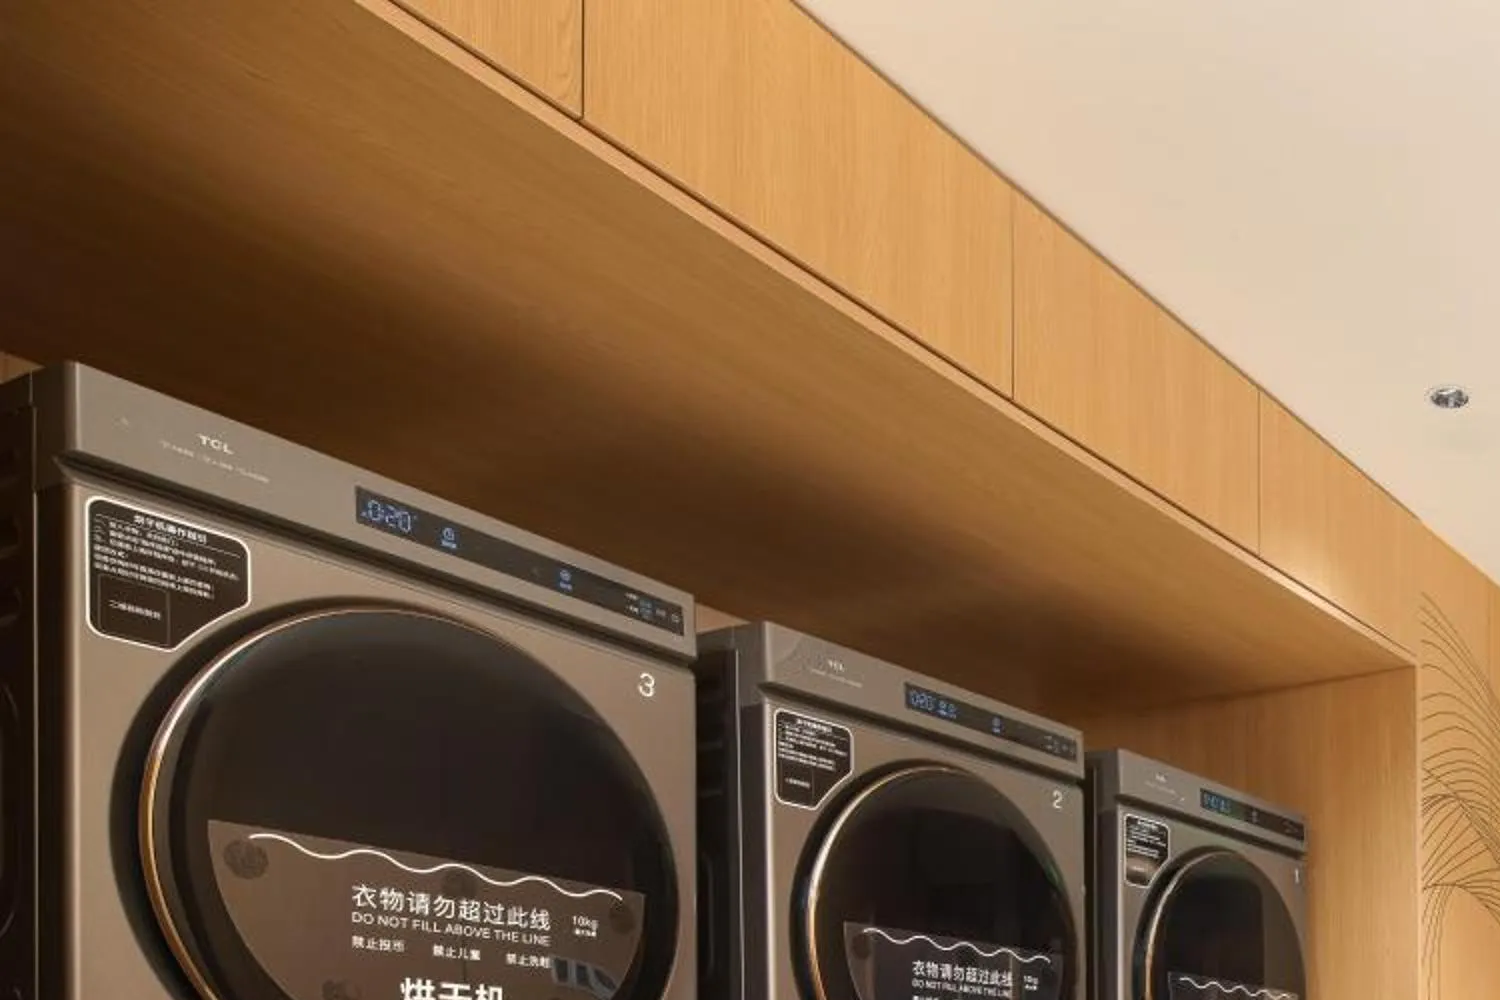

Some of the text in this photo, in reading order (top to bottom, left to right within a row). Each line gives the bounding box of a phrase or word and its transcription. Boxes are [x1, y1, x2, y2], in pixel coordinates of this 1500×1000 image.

[197, 433, 235, 455] TCL
[637, 672, 655, 697] 3
[1052, 789, 1063, 809] 2
[351, 884, 551, 931] 衣物请勿超过此线
[351, 911, 551, 947] DO NOT FILL ABOVE THE LINE
